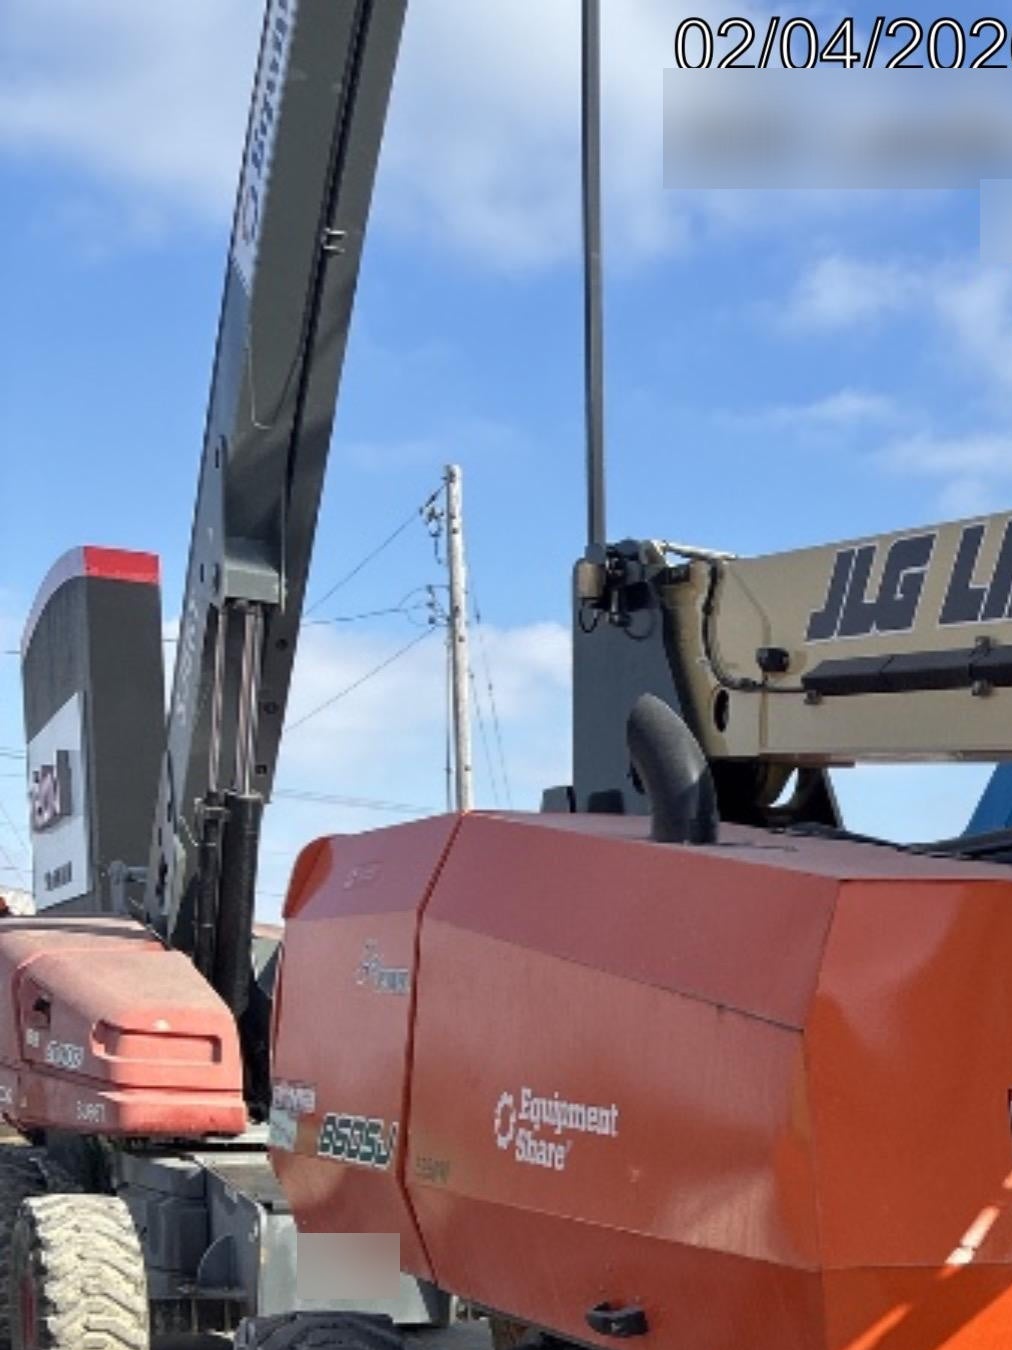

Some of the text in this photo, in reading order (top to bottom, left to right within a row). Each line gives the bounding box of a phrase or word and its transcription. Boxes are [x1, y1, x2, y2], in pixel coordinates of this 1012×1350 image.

[804, 529, 939, 642] JLG
[518, 1087, 619, 1137] Equipment
[515, 1127, 566, 1171] Share
